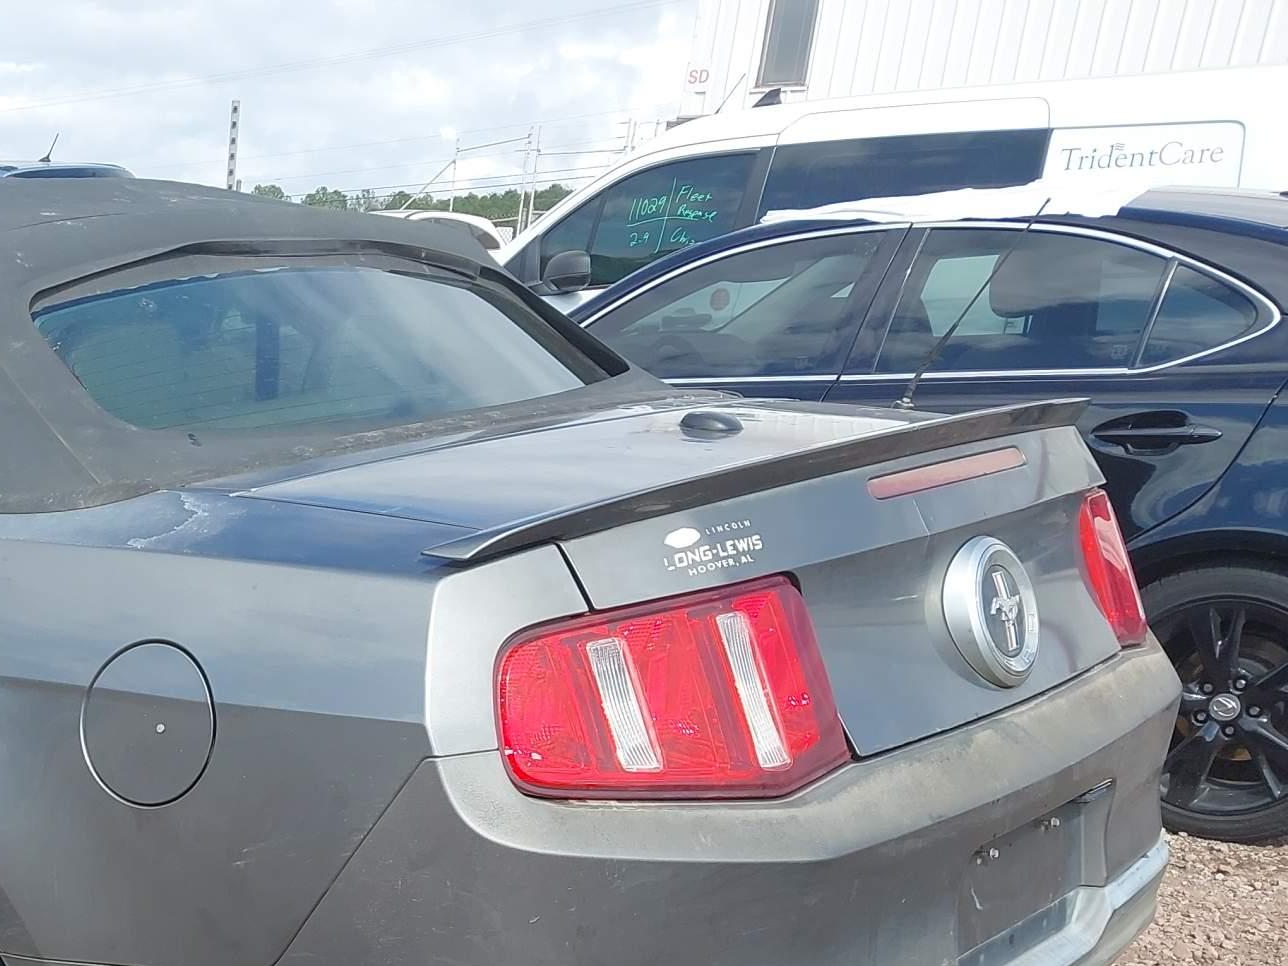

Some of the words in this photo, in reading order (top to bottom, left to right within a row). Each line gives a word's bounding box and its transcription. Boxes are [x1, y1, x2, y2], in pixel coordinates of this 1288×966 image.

[688, 69, 709, 84] SD
[1062, 141, 1224, 171] TridentCare
[676, 185, 713, 204] Fleet
[629, 196, 667, 220] 11029
[705, 520, 751, 535] LINCOLN
[664, 535, 763, 571] LONG-LEWIS
[688, 558, 740, 576] HOOVER,
[741, 554, 755, 563] AL
